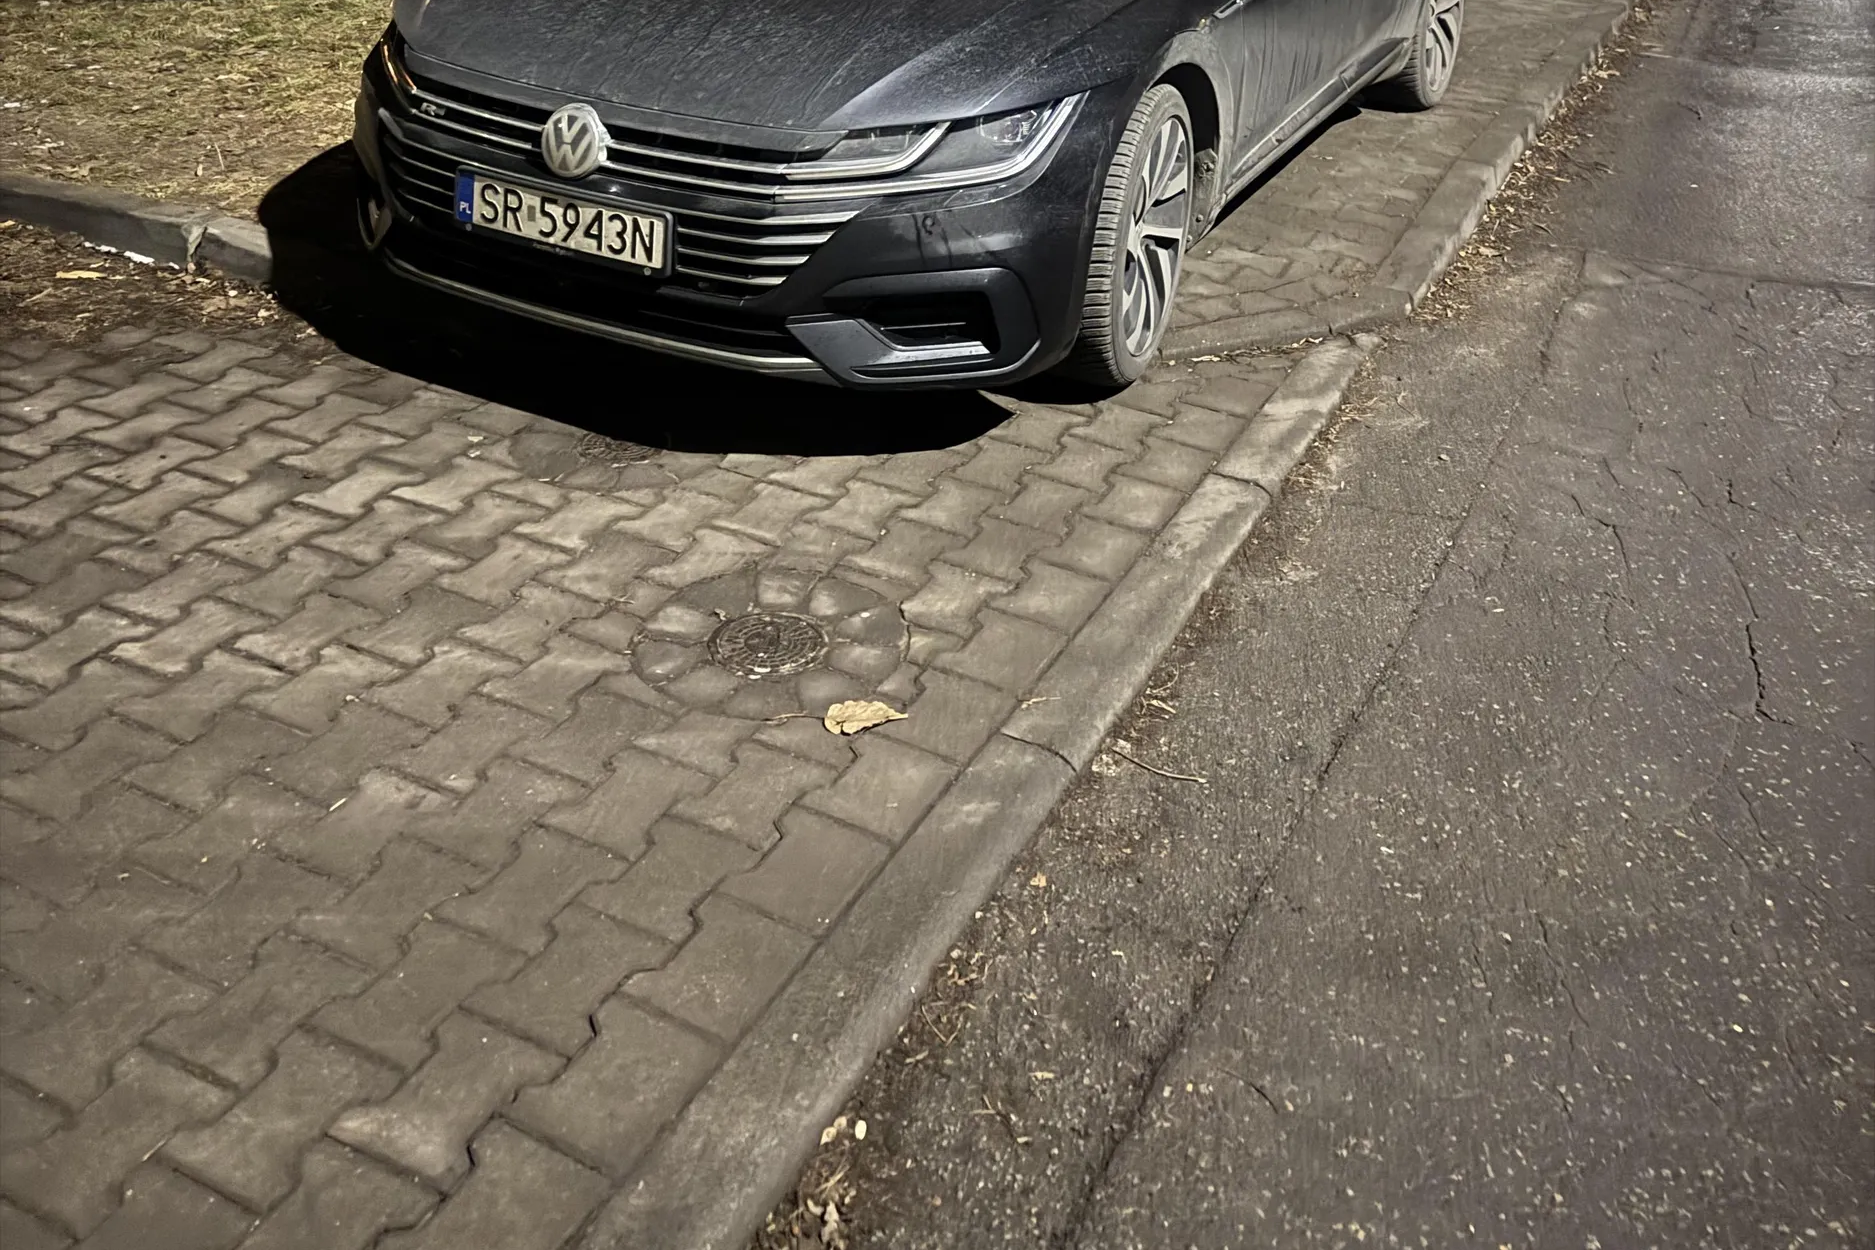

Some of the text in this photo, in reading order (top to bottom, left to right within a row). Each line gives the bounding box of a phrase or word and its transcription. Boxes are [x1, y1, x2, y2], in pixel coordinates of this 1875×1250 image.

[459, 201, 472, 214] PL
[480, 183, 655, 263] SR 5943N
